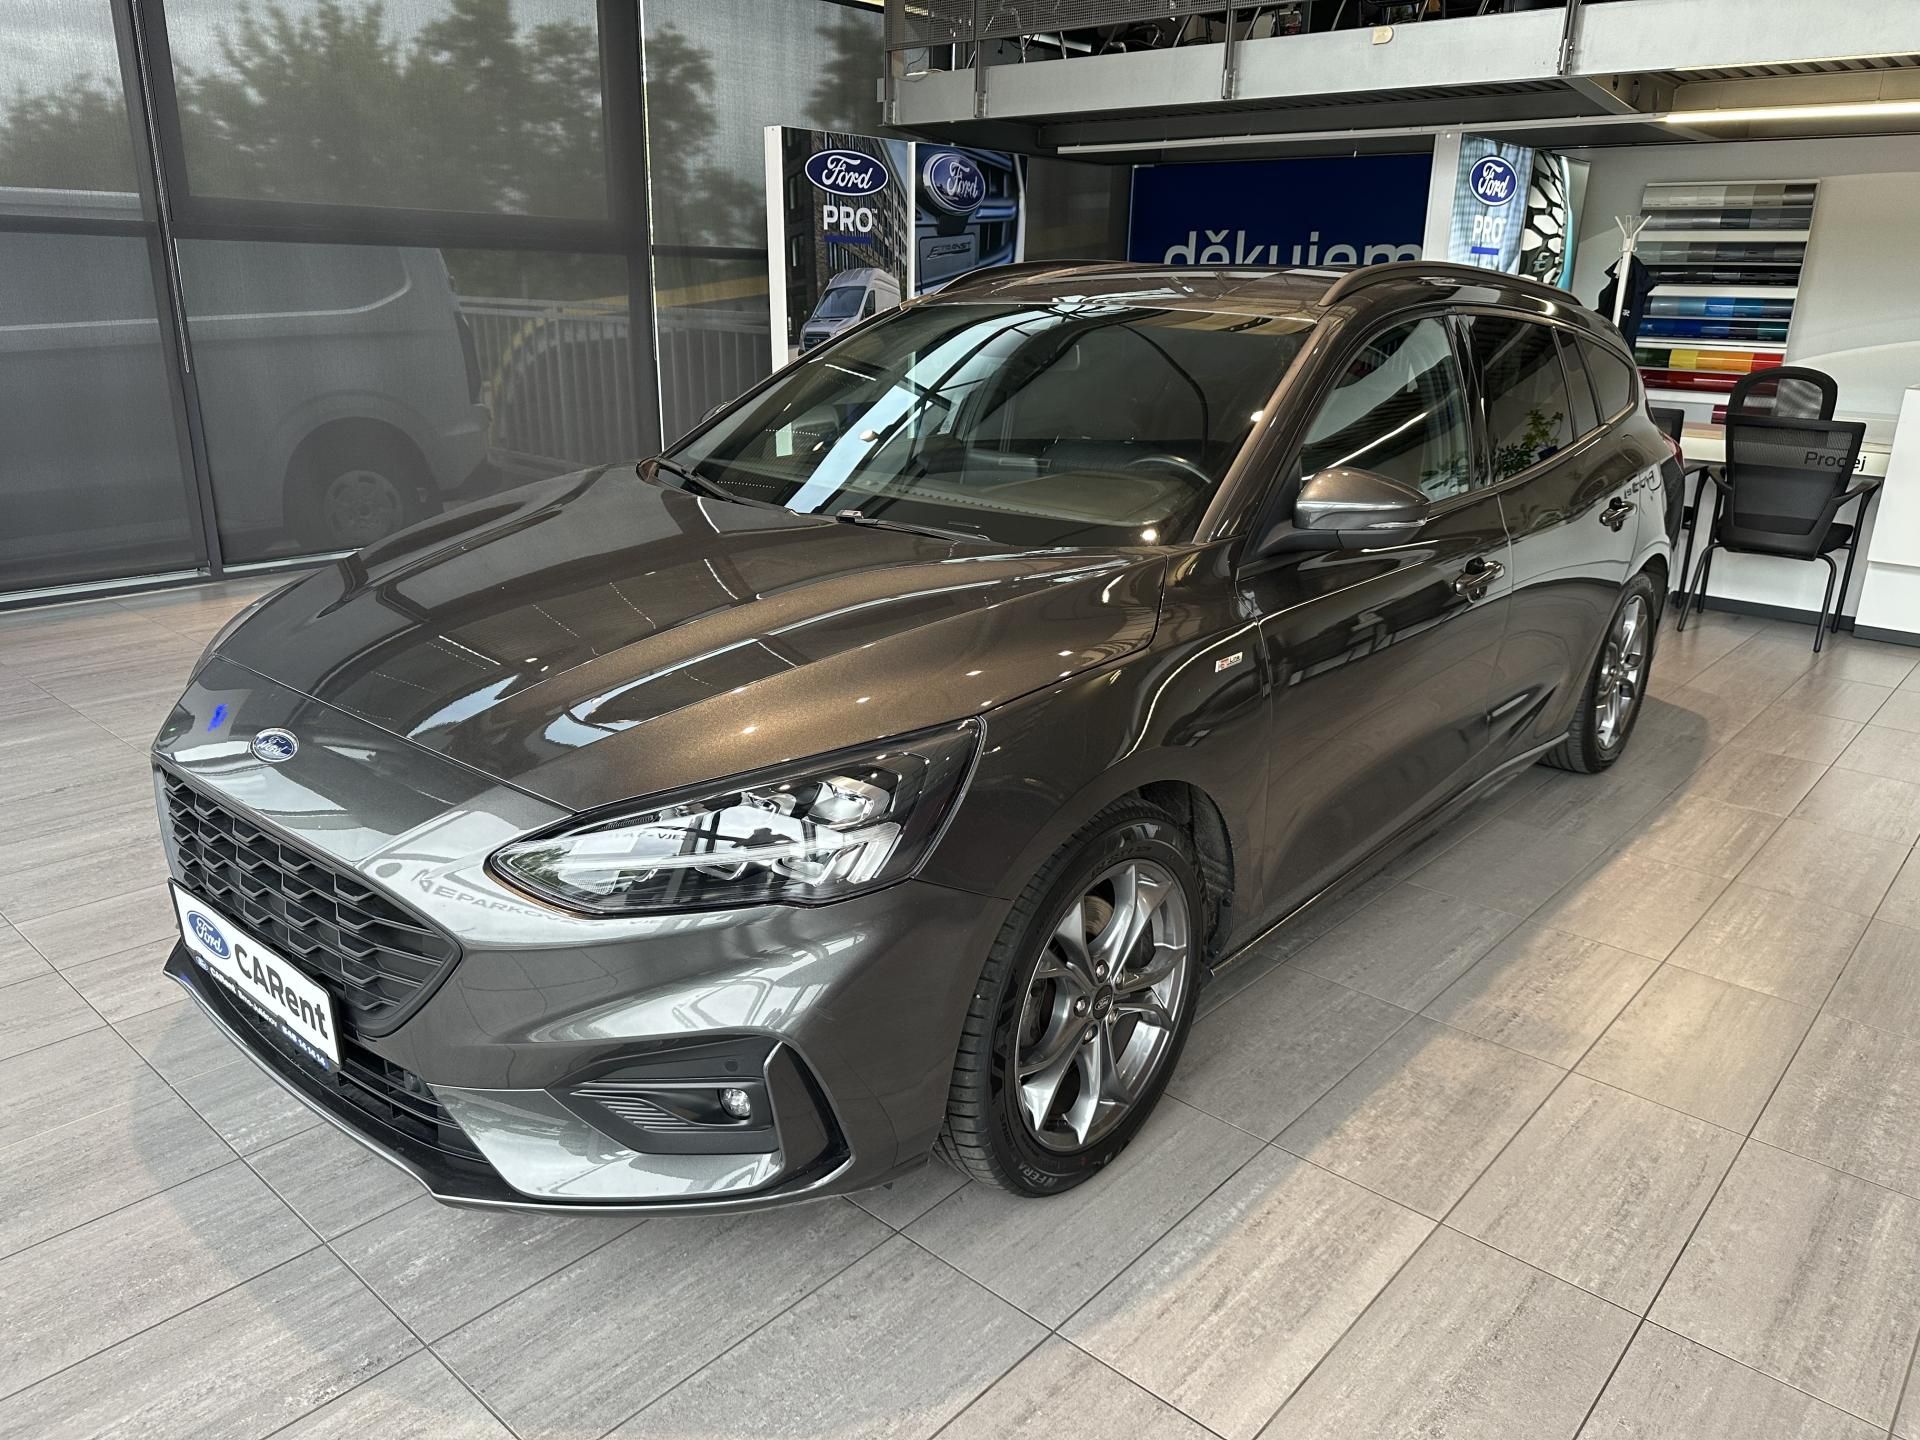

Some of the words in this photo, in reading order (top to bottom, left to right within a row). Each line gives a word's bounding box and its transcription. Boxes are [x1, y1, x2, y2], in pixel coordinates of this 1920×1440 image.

[822, 155, 873, 189] Ford
[946, 161, 979, 199] Ford
[1478, 162, 1510, 198] Ford
[196, 917, 223, 953] Ford
[235, 944, 329, 1040] CARent
